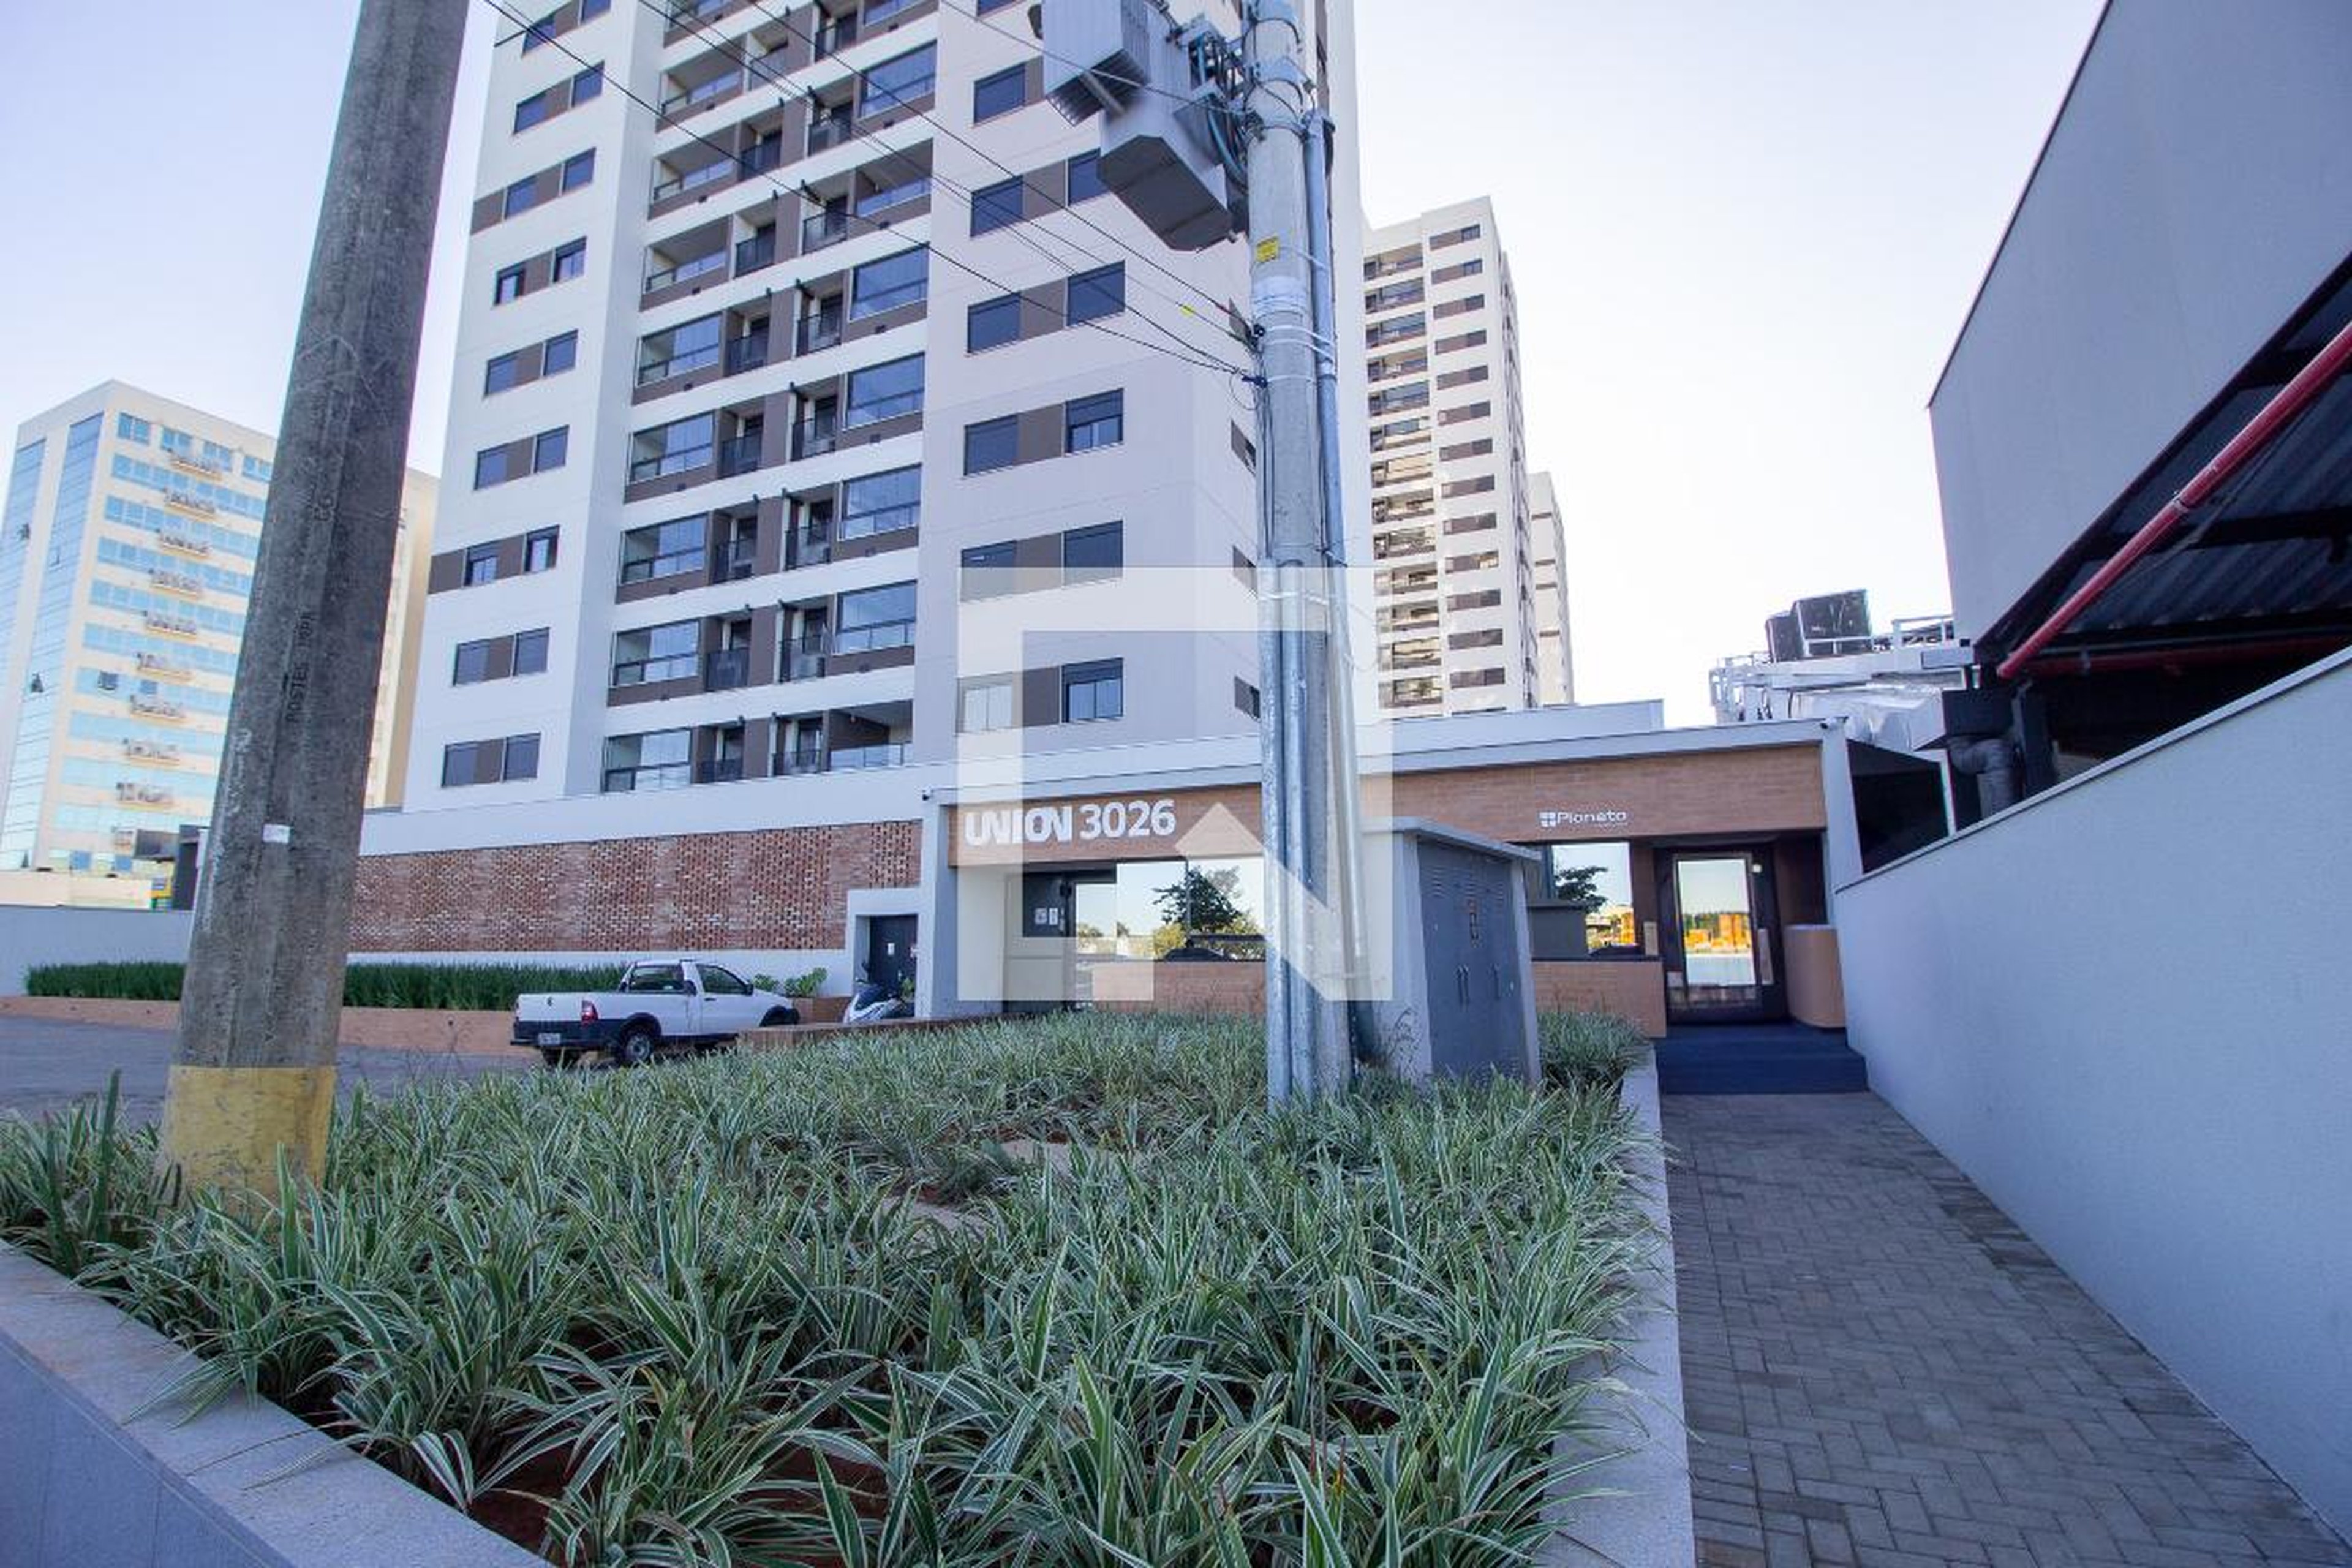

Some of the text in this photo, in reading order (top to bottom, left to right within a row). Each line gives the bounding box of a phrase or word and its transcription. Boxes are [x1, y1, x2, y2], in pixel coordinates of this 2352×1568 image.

[965, 799, 1177, 846] UNION 3026
[1558, 810, 1627, 824] Planeta
